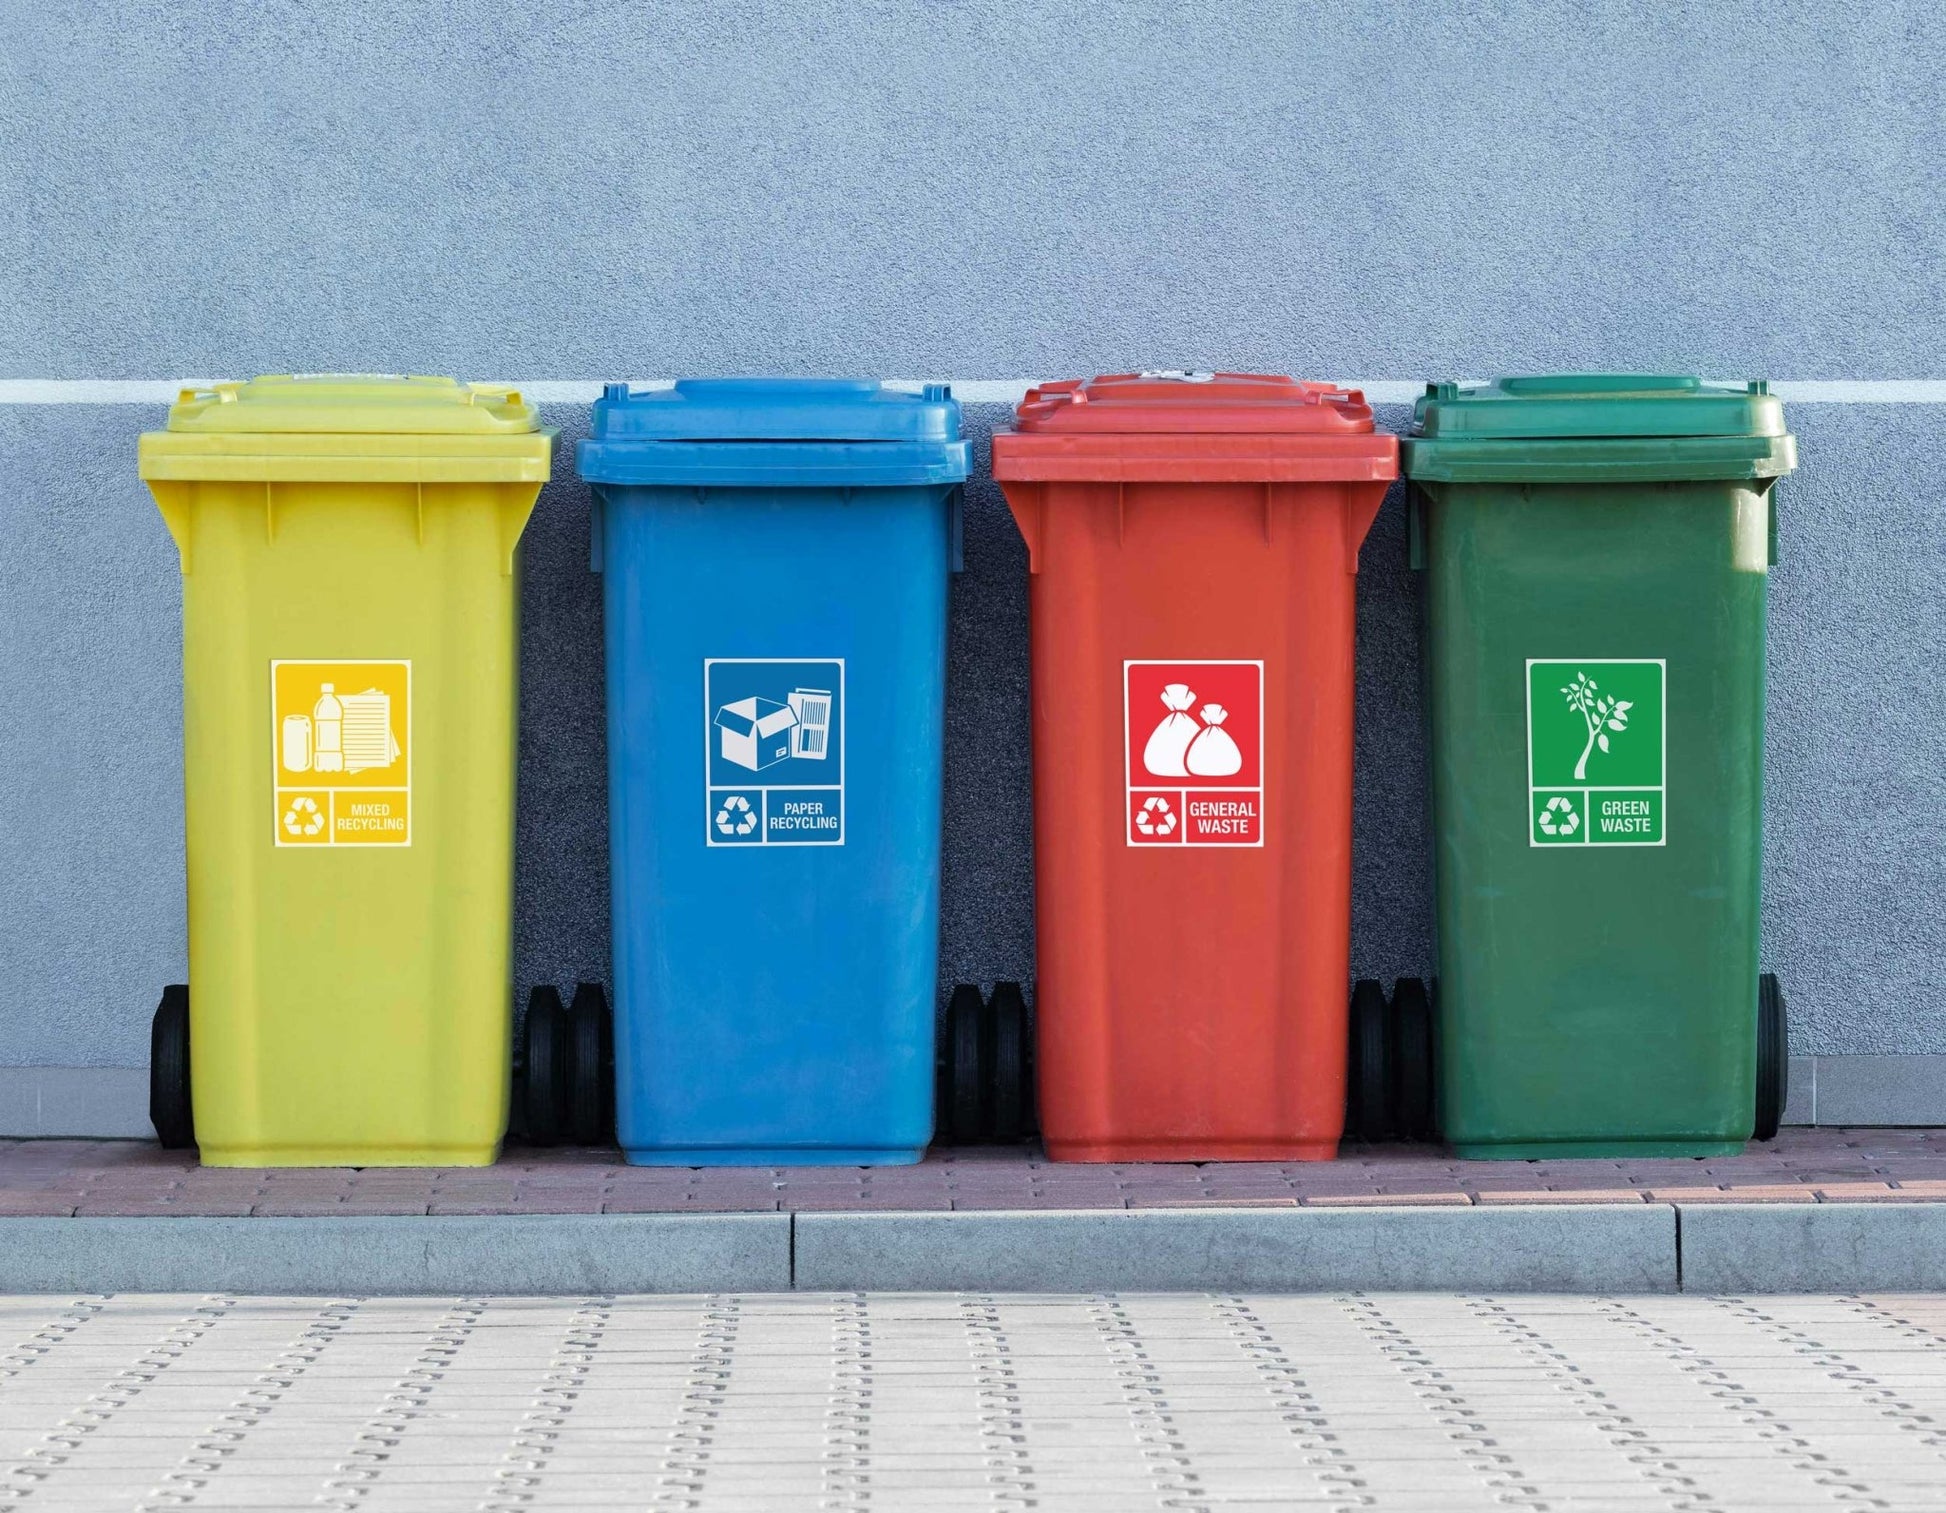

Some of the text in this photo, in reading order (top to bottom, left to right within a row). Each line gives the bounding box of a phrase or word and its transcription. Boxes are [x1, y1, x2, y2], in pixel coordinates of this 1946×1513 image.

[351, 804, 390, 816] MIXED
[784, 802, 823, 815] PAPER
[1189, 801, 1257, 817] GENERAL
[1602, 800, 1650, 816] GREEN
[337, 817, 404, 831] RECYCLING
[770, 816, 838, 830] RECYCLING
[1197, 819, 1249, 834] WASTE
[1600, 818, 1651, 833] WASTE
